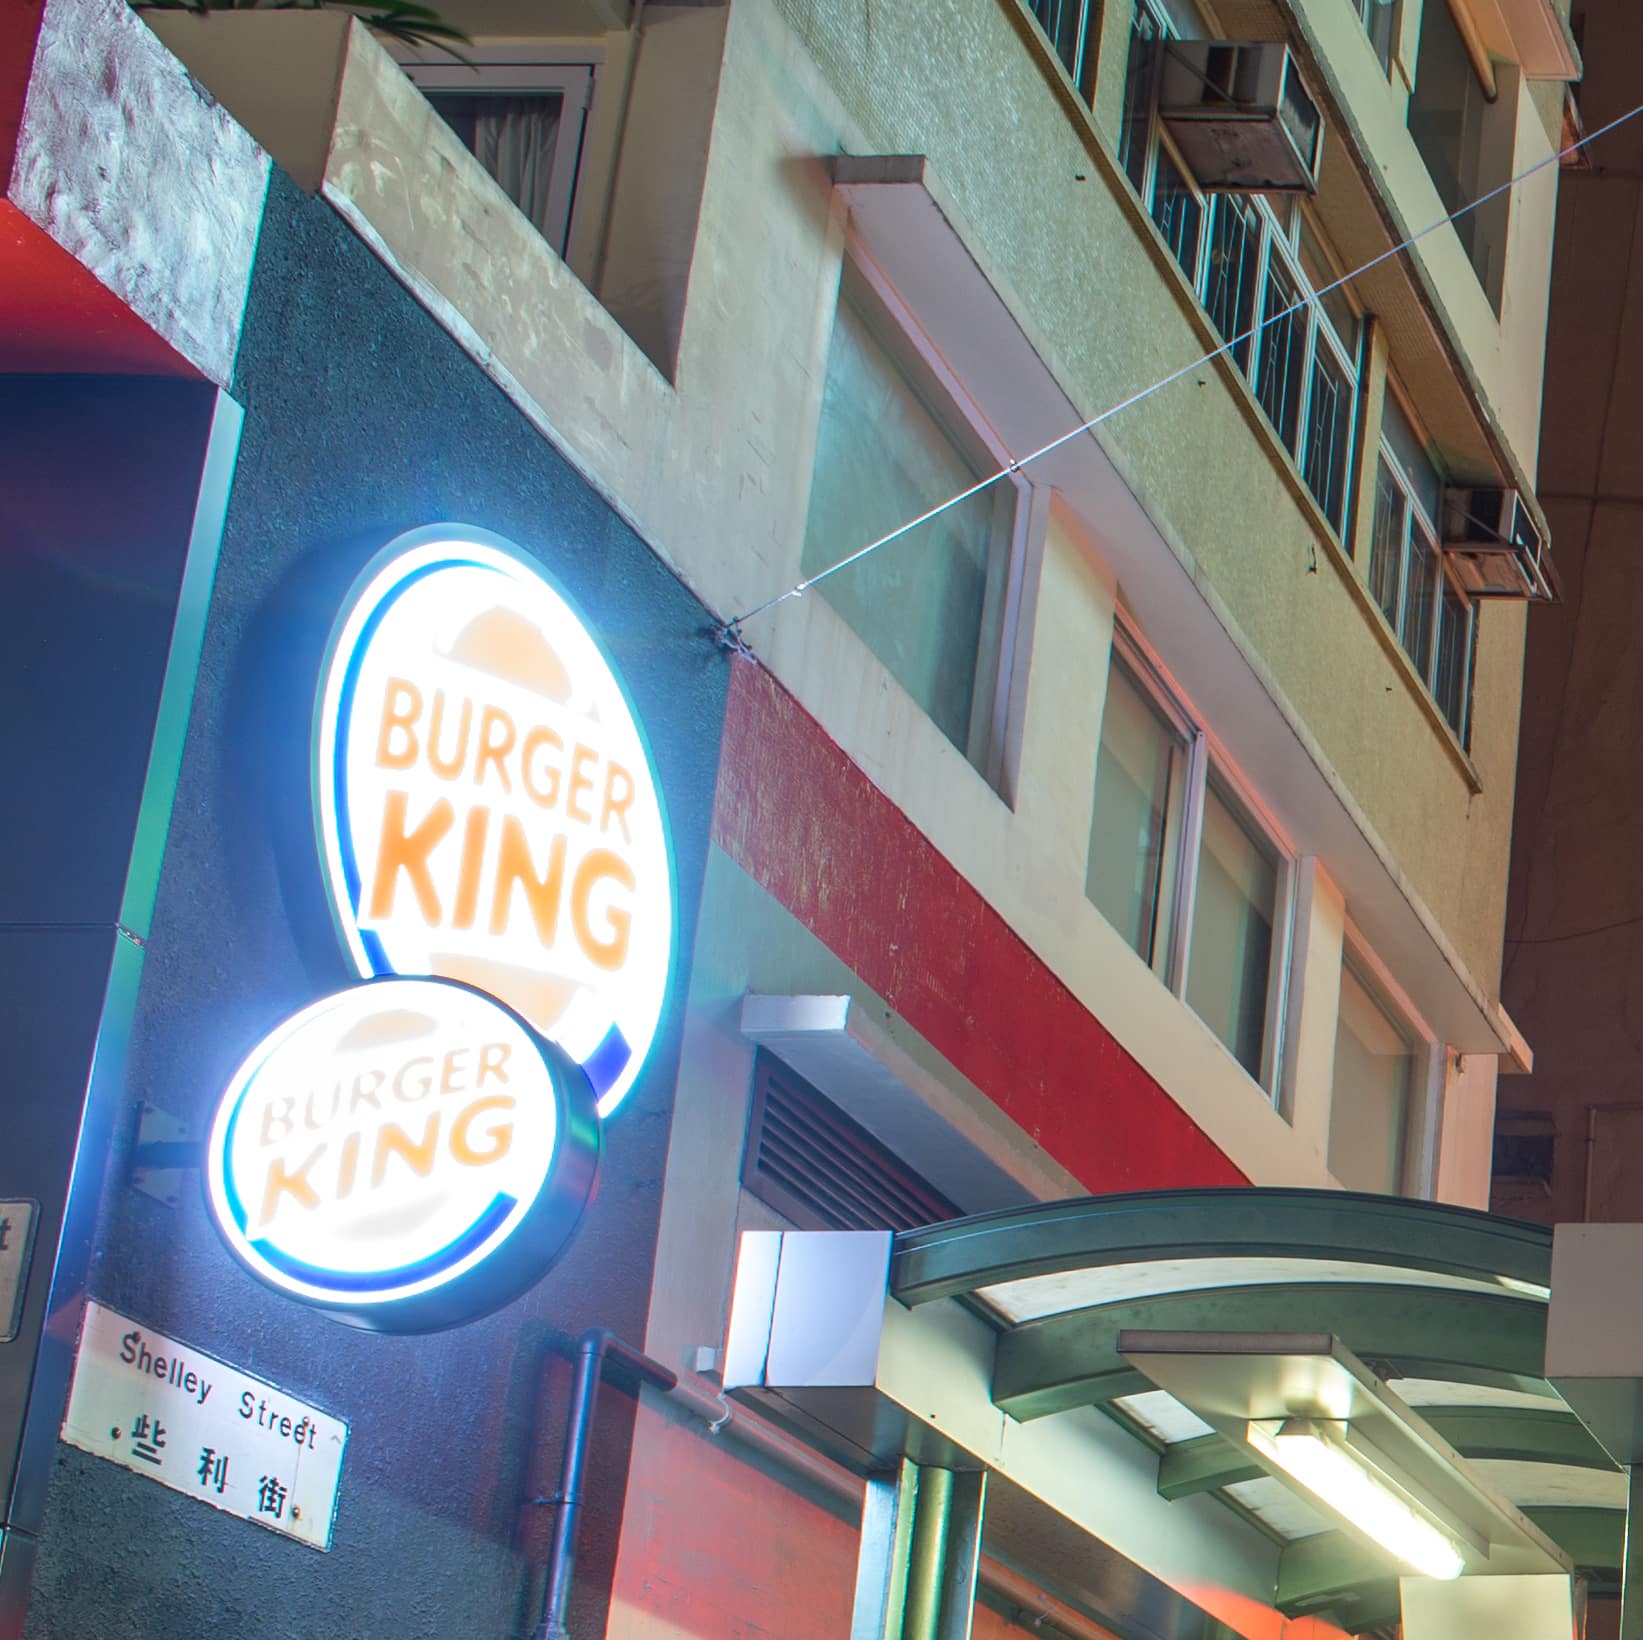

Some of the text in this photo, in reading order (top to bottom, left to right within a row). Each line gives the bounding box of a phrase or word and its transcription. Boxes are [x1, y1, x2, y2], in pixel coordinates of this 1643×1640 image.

[374, 675, 638, 846] BURGER
[370, 790, 639, 971] KING
[257, 1040, 514, 1147] BURGER
[256, 1094, 518, 1230] KING
[118, 1331, 318, 1451] Shelley Street
[130, 1413, 290, 1519] 些利街
